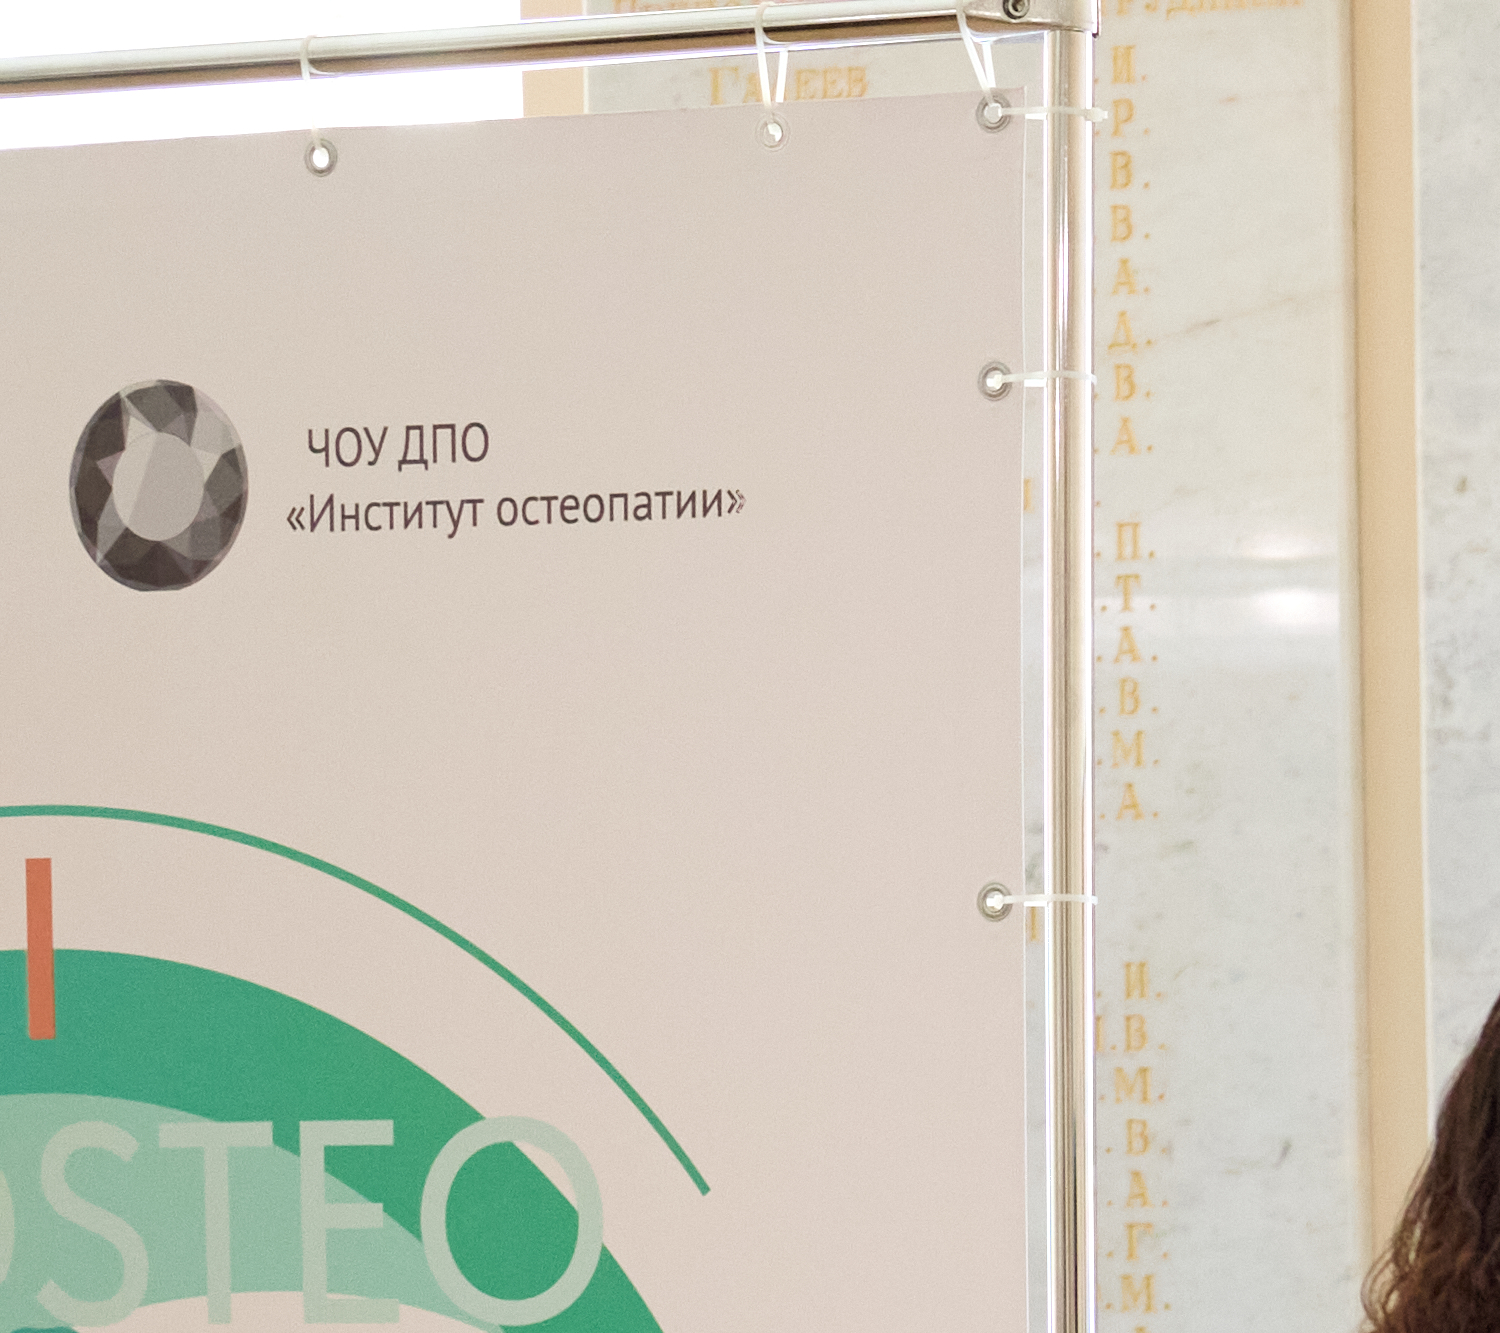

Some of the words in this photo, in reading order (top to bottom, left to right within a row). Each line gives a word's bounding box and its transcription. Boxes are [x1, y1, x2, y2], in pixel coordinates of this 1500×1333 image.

[307, 425, 388, 468] ЧОУ
[397, 421, 490, 472] ДПО
[285, 492, 484, 539] «Институт
[496, 487, 746, 530] остеопатии»
[0, 1116, 603, 1327] STEO
